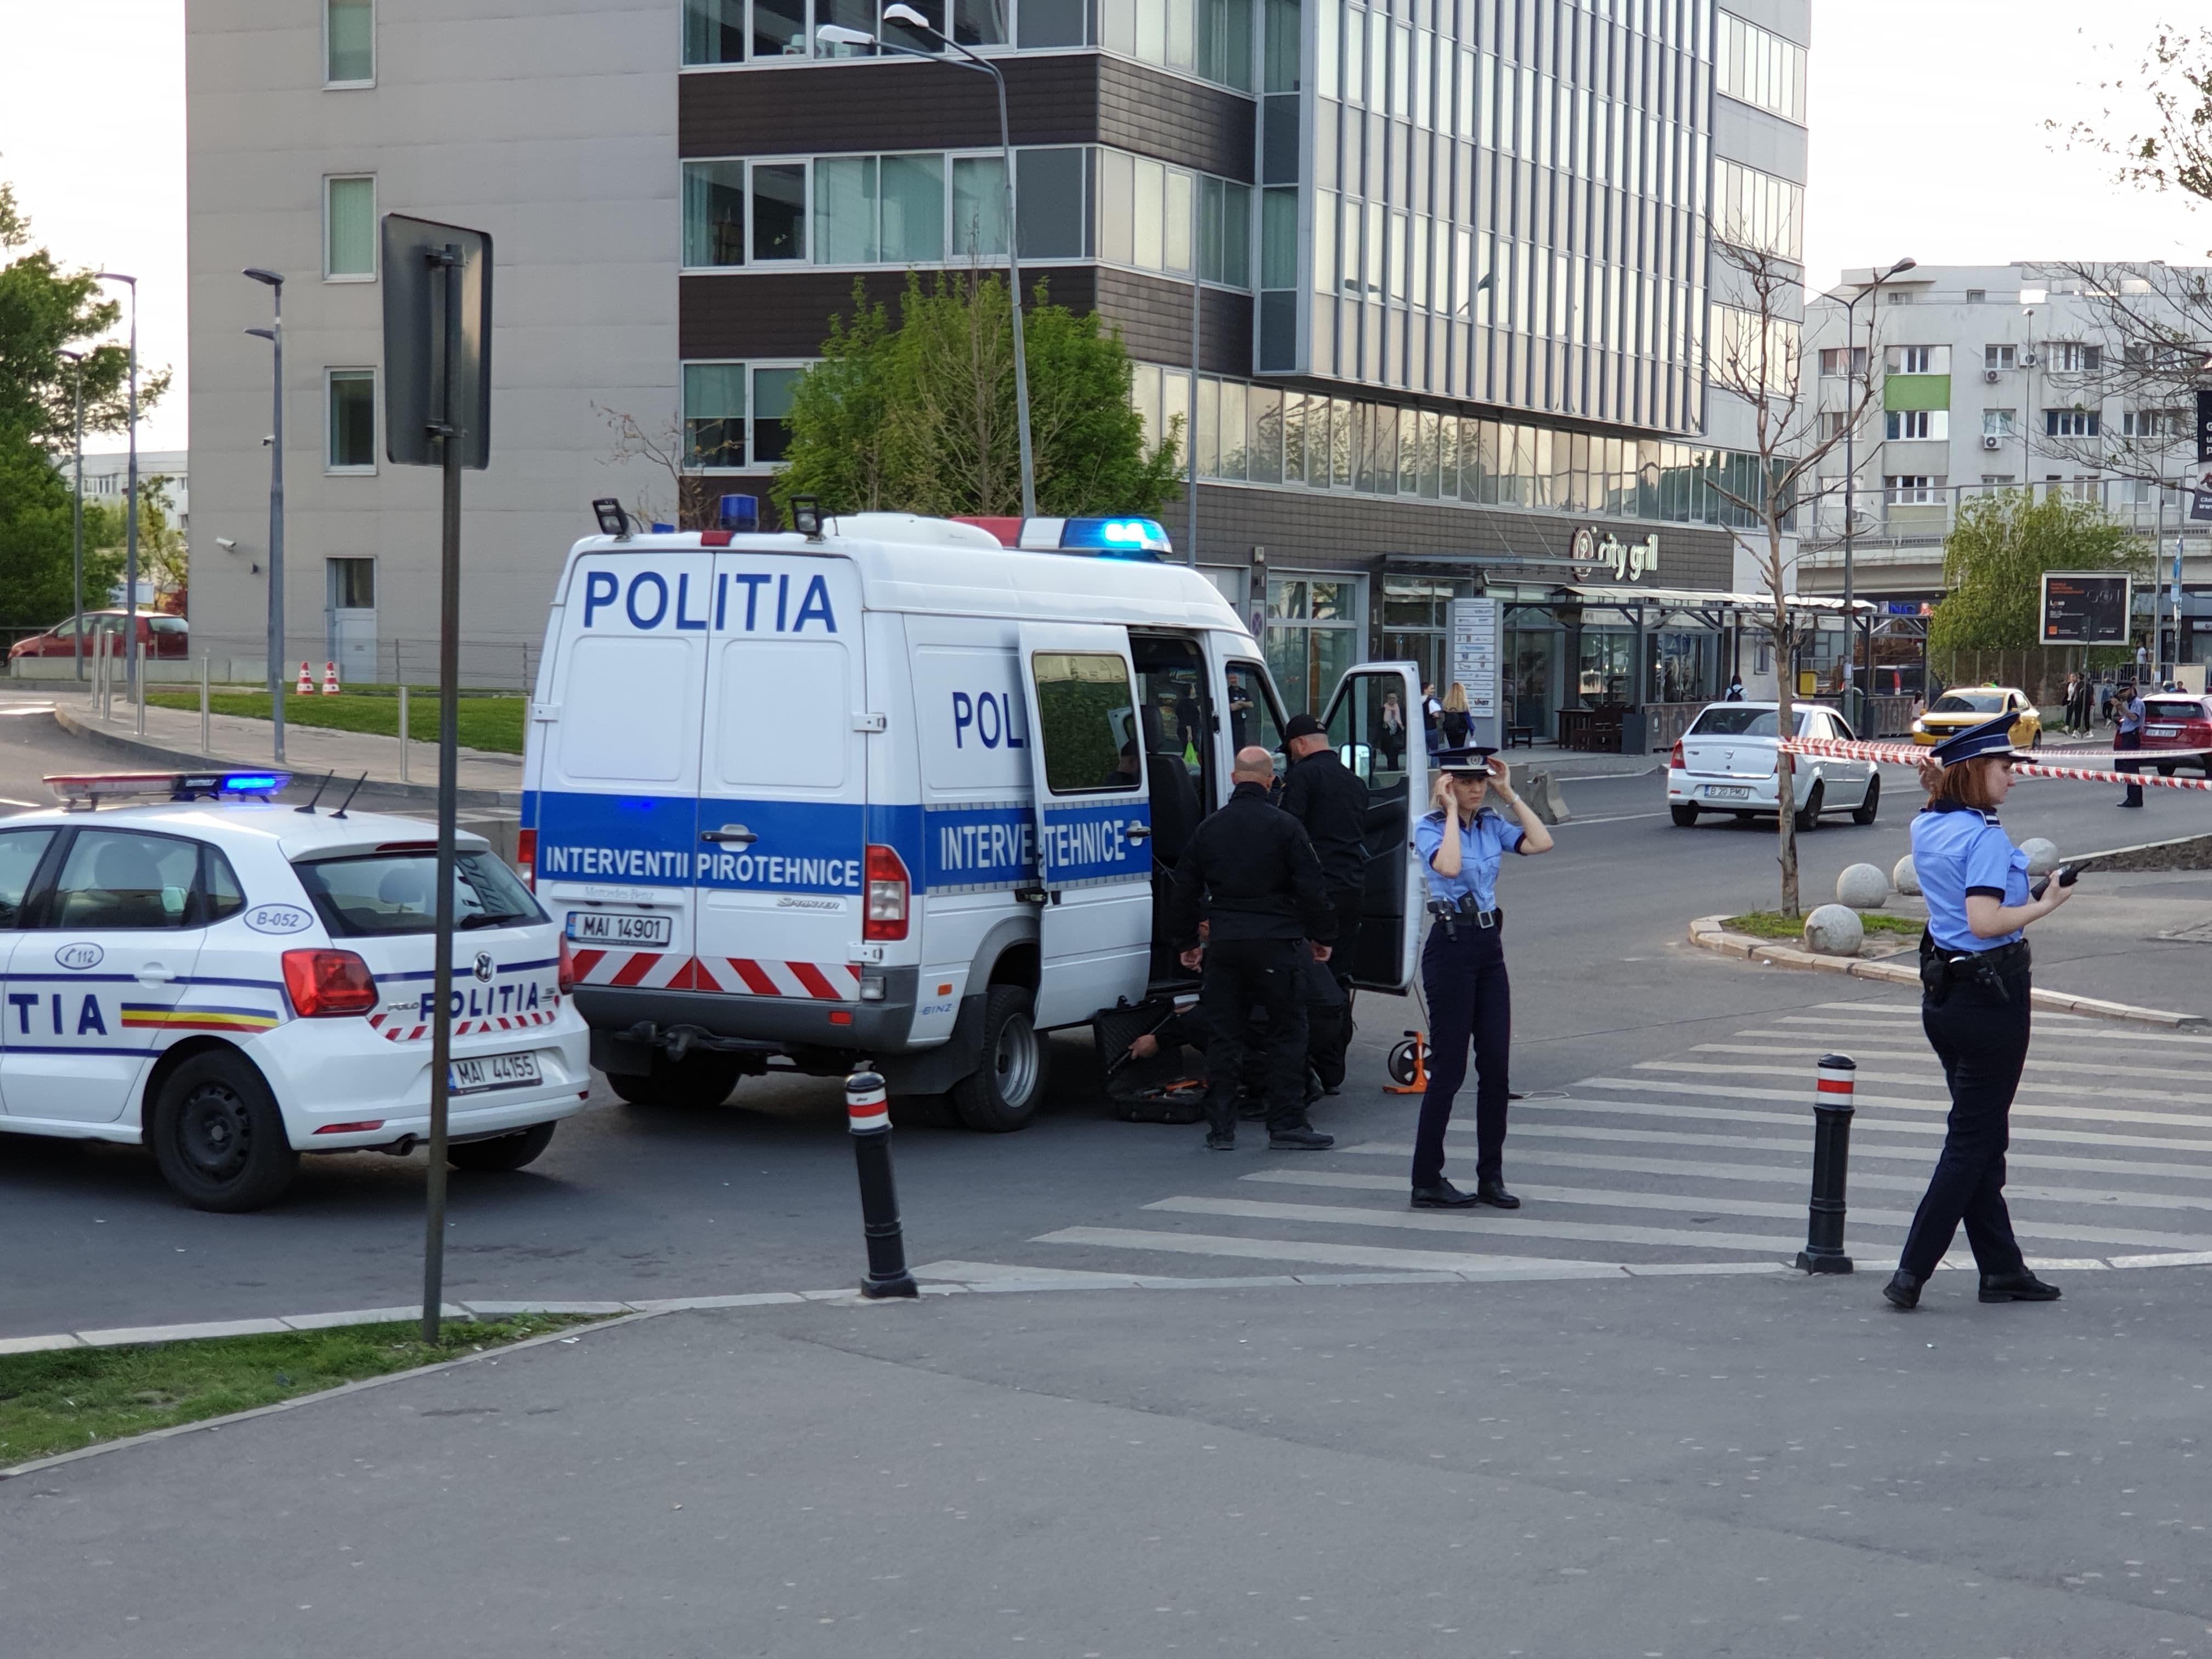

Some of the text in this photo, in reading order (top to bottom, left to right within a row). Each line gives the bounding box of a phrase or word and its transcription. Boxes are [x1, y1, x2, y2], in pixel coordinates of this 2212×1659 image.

[1598, 532, 1658, 582] city grill
[584, 571, 838, 633] POLITIA
[952, 691, 1030, 750] POL
[545, 845, 860, 887] INTERVENTII PIROTEHNICE
[940, 823, 1032, 871] INTERVE
[256, 912, 299, 927] B-052
[583, 916, 661, 939] MAI 14901
[77, 949, 94, 964] 112
[8, 993, 108, 1036] TIA
[419, 981, 539, 1022] POLITIA
[456, 1055, 535, 1086] MAI 44155
